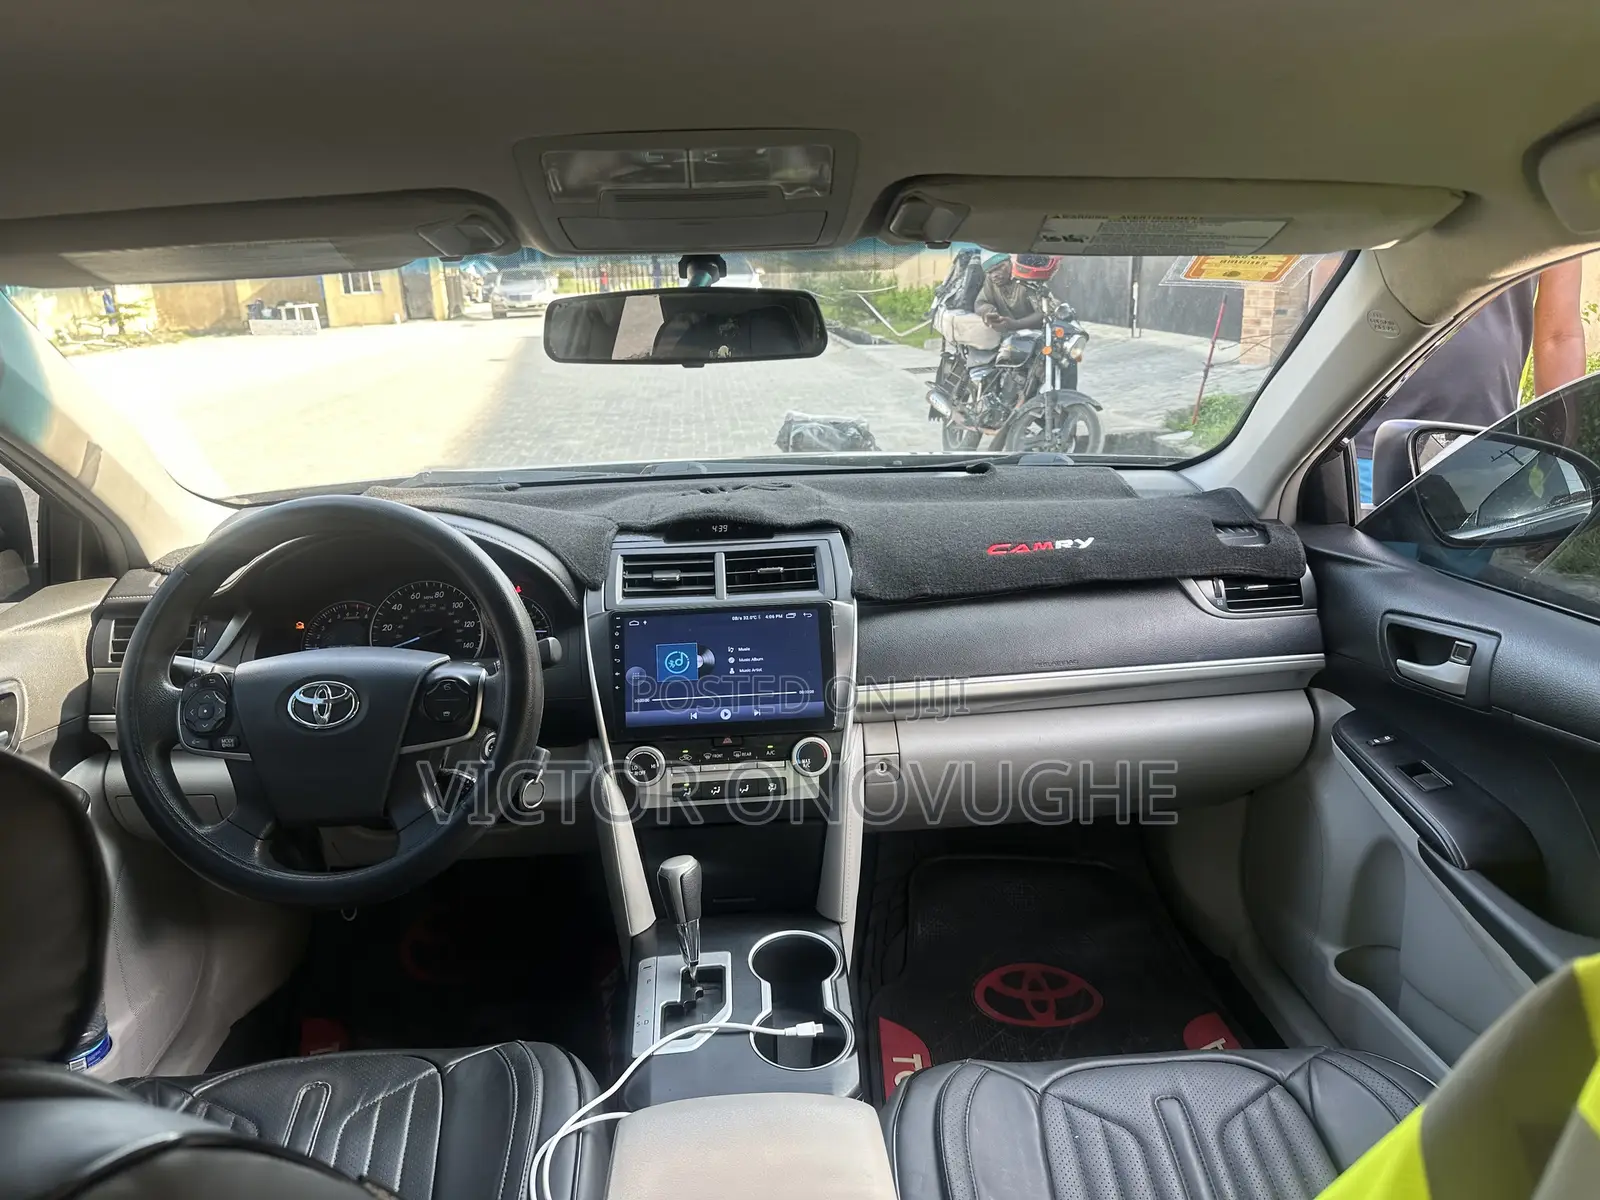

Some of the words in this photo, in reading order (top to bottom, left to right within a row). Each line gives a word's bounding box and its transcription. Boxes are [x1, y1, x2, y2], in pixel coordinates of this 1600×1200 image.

[986, 536, 1095, 556] CAMRY
[410, 592, 421, 600] 60
[434, 591, 445, 599] 80
[391, 603, 403, 611] 40
[452, 601, 464, 609] 100
[381, 623, 393, 632] 20
[463, 620, 476, 628] 120
[462, 641, 475, 649] 140
